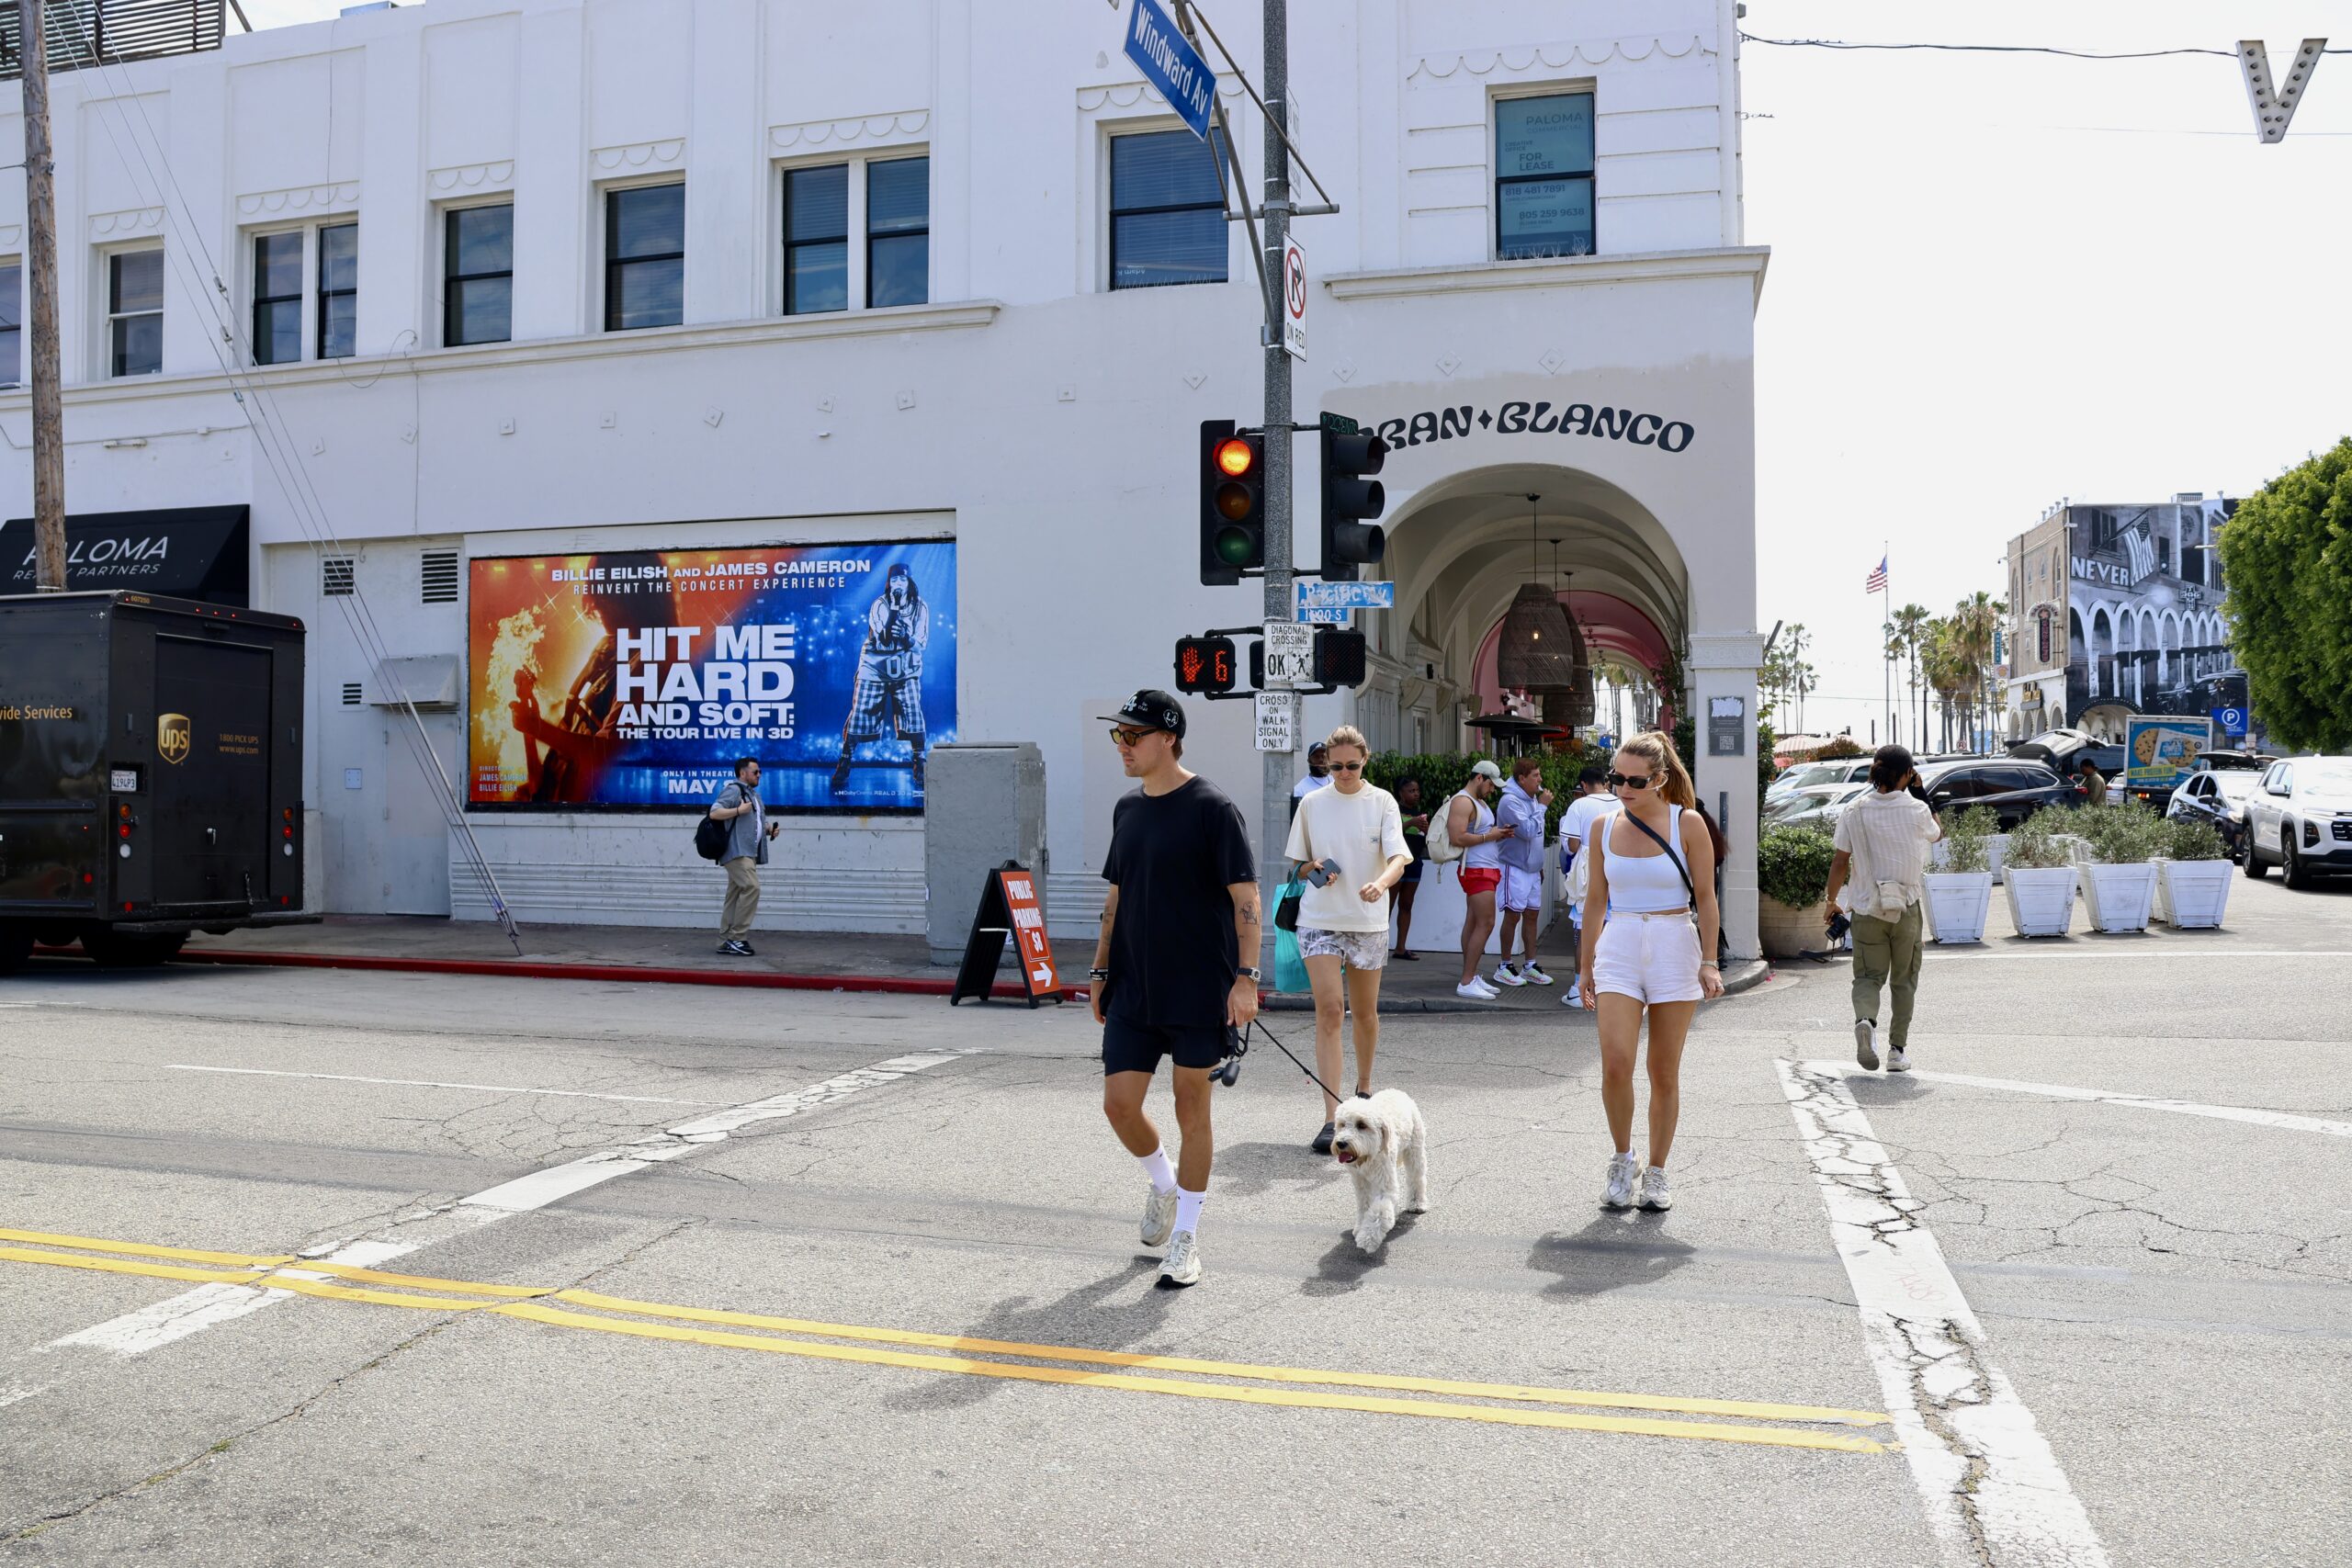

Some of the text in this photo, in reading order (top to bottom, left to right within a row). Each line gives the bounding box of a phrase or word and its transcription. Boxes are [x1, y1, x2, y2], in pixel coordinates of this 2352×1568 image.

[1135, 2, 1208, 116] Windward Av
[2235, 38, 2329, 143] V
[1526, 112, 1582, 126] PALOMA
[1527, 125, 1582, 134] COMMERCIAL
[1519, 152, 1543, 162] FOR
[1520, 161, 1555, 172] LEASE
[1505, 184, 1566, 197] 818 481 7891
[1519, 208, 1585, 220] 805 259 9638
[1286, 322, 1305, 349] ON RED
[1359, 401, 1694, 453] RAN BLANCO
[22, 536, 168, 566] LOMA
[76, 564, 161, 577] PARTNERS
[551, 559, 870, 581] BILLIE EILISH AND JAMES CAMERON
[2071, 556, 2129, 587] NEVER
[573, 577, 845, 595] REINVENT THE CONCERT EXPERIENCE
[1335, 609, 1341, 620] S
[1271, 626, 1306, 635] DIAGONAL
[616, 625, 795, 661] HIT ME
[1271, 636, 1307, 645] CROSSING
[1215, 649, 1227, 682] 6
[1268, 654, 1285, 676] OK
[616, 661, 795, 702] HARD
[1260, 695, 1288, 705] CROSS
[24, 705, 73, 720] Services
[616, 702, 795, 726] AND SOFT:
[1269, 706, 1279, 715] ON
[219, 733, 259, 745] 1800 PICK UPS
[616, 727, 794, 739] THE TOUR LIVE IN 3D
[1259, 728, 1289, 737] SIGNAL
[161, 728, 187, 757] ups
[1262, 739, 1284, 748] ONLY
[219, 745, 259, 755] www.ups.com
[479, 773, 527, 782] JAMES CAMERON
[479, 784, 517, 792] BILLIE EILISH
[668, 779, 718, 794] MAY
[1007, 880, 1033, 900] PUBLIC
[1012, 908, 1043, 928] PARKING
[1031, 931, 1044, 953] $8
